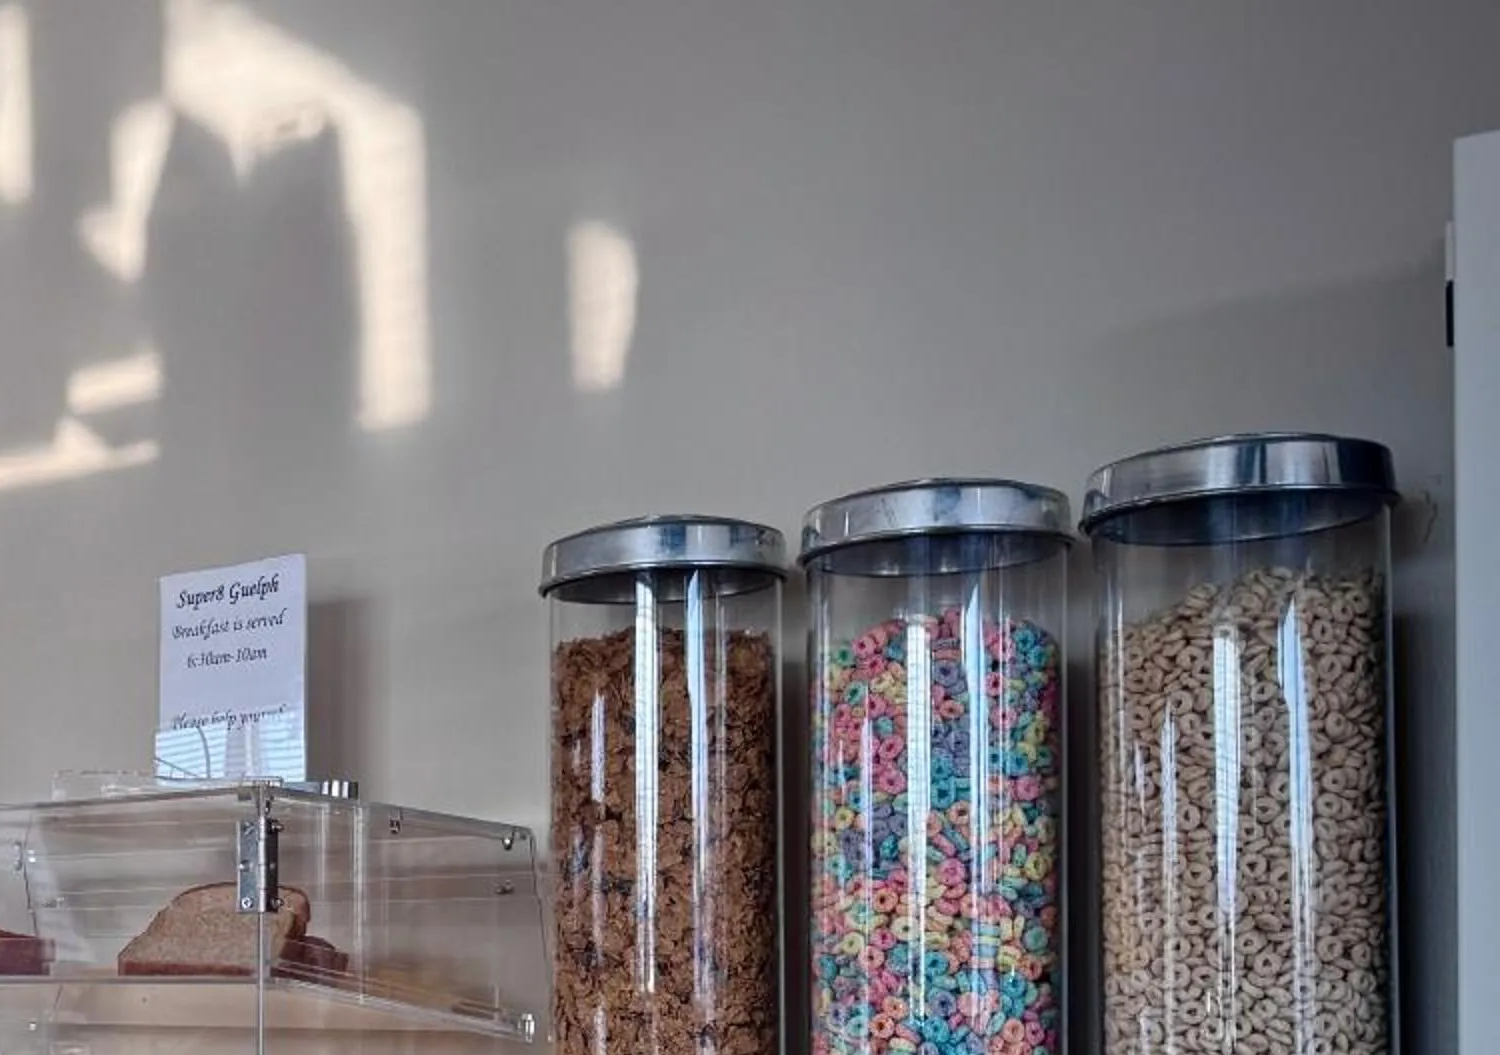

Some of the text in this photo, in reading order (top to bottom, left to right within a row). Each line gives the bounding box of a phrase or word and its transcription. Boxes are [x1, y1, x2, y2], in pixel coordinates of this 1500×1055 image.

[176, 573, 279, 611] Super8 Guelph
[171, 607, 287, 640] Breakfast is served
